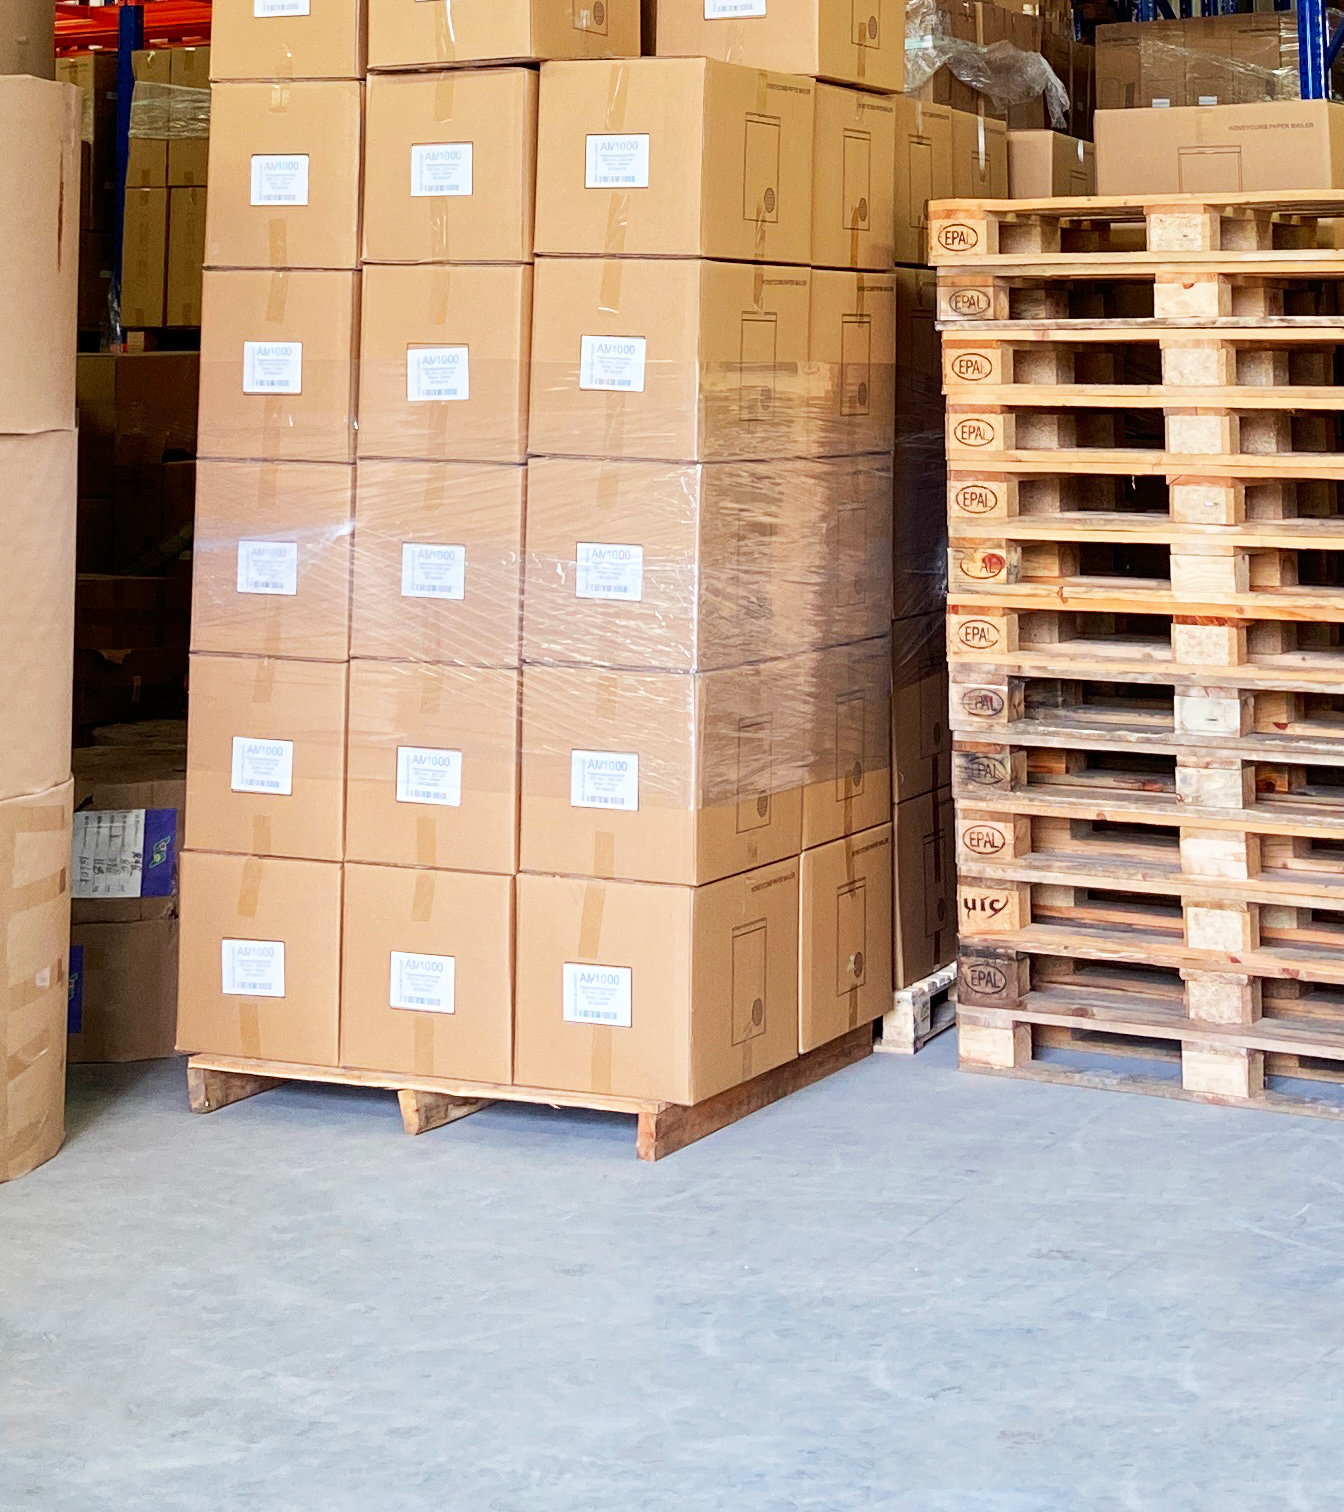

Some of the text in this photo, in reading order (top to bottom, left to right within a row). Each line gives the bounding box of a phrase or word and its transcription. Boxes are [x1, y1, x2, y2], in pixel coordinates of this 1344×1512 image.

[945, 230, 972, 246] EPAL
[955, 295, 984, 310] EPAL
[959, 360, 986, 374] EPAL
[961, 425, 989, 441] EPAL
[963, 492, 992, 508] EPAL
[965, 627, 994, 642] EPAL
[969, 832, 1000, 847] EPAL
[970, 970, 1001, 988] EPAL
